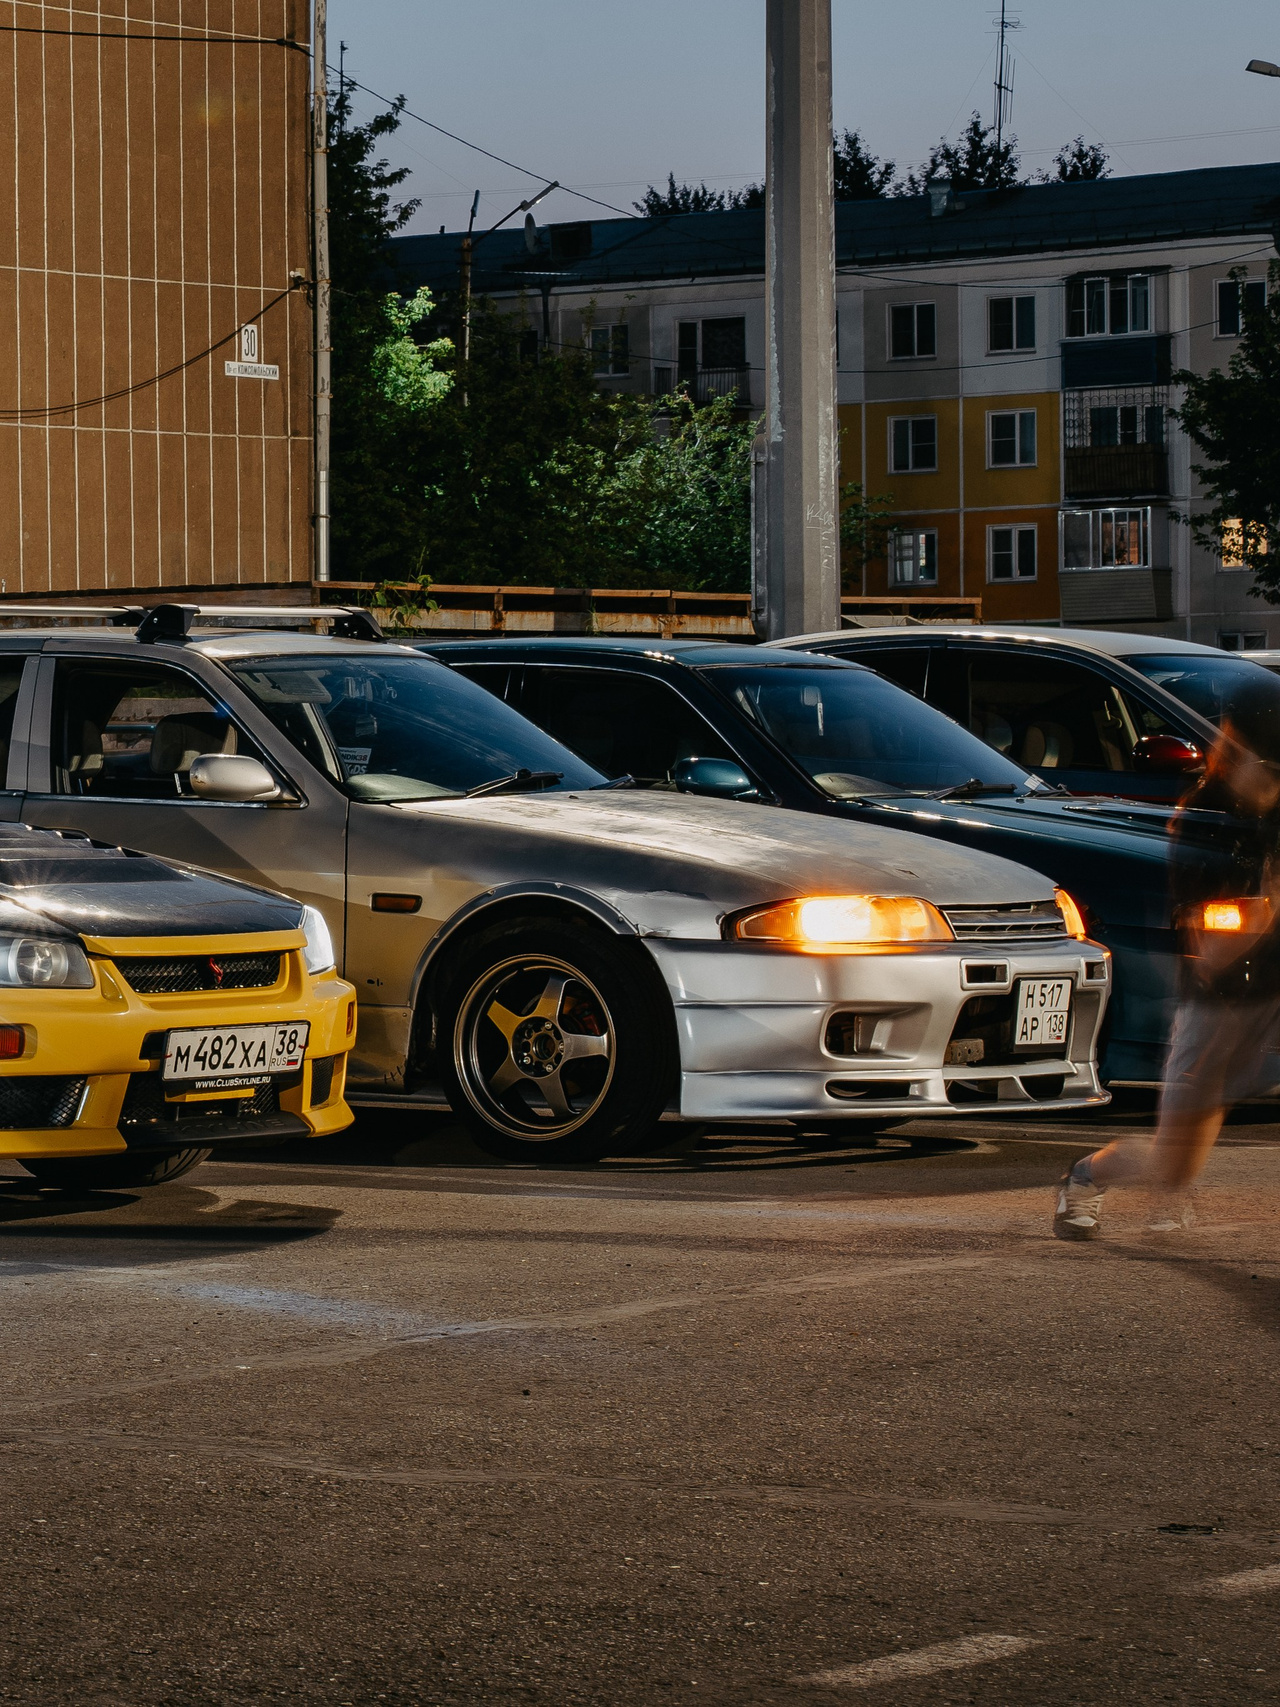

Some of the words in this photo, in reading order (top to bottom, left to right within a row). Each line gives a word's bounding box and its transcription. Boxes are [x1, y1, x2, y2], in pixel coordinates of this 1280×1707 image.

[243, 328, 256, 358] 30
[1025, 984, 1036, 1008] Н
[1039, 983, 1063, 1008] 517
[1019, 1016, 1039, 1041] АР
[1046, 1014, 1064, 1033] 138
[275, 1028, 299, 1056] 38
[271, 1057, 287, 1067] RUS
